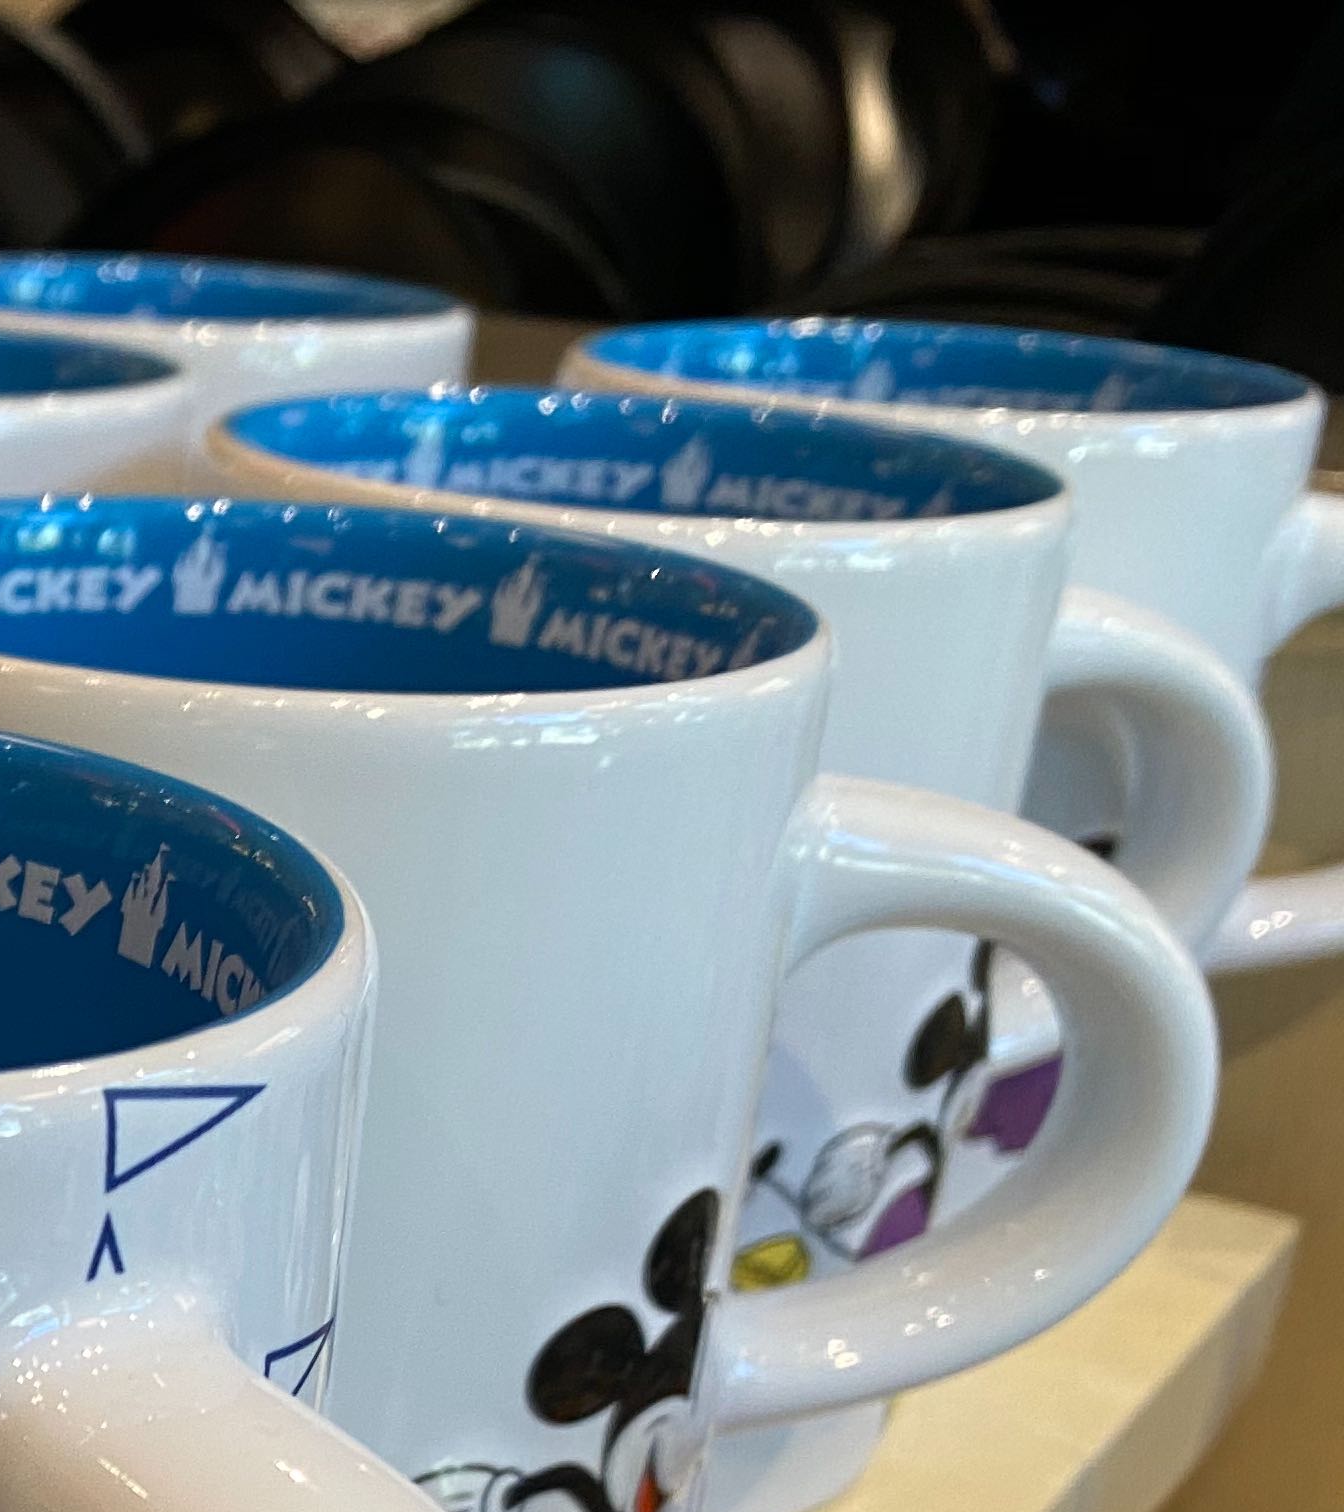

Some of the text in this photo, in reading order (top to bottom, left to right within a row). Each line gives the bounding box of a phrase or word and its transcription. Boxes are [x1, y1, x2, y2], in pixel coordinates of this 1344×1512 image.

[226, 571, 483, 635] MICKEY
[537, 607, 724, 681] MICKEY
[161, 920, 265, 1016] MICK
